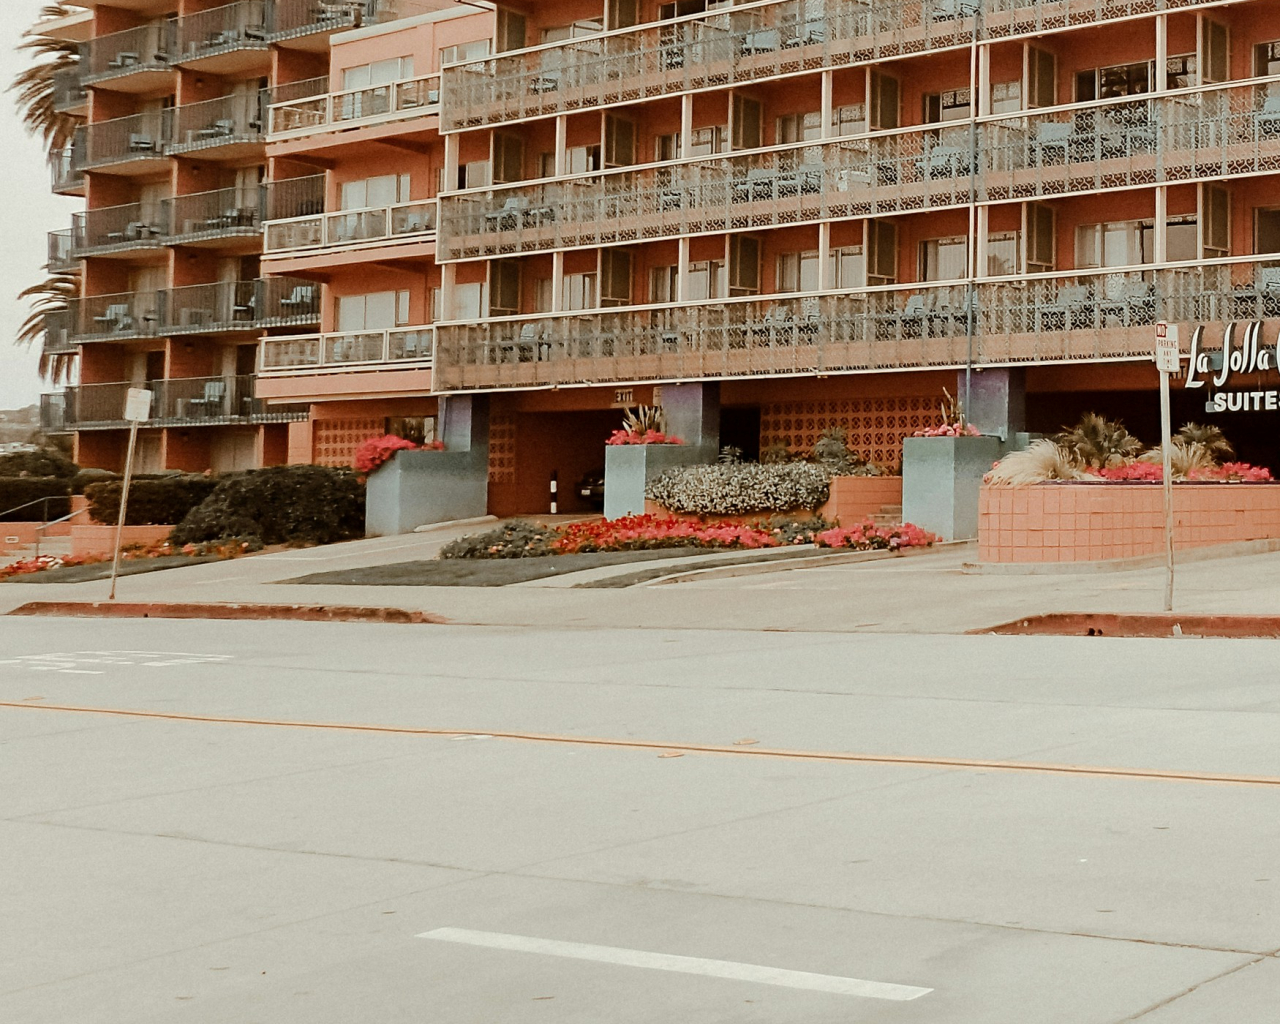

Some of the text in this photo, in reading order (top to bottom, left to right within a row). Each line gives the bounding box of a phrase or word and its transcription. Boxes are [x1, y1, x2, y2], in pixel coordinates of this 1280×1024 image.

[1157, 325, 1166, 336] NO
[1158, 339, 1177, 349] PARKING
[1185, 325, 1209, 388] La
[1213, 321, 1270, 387] Jolla
[615, 390, 633, 403] EXIT
